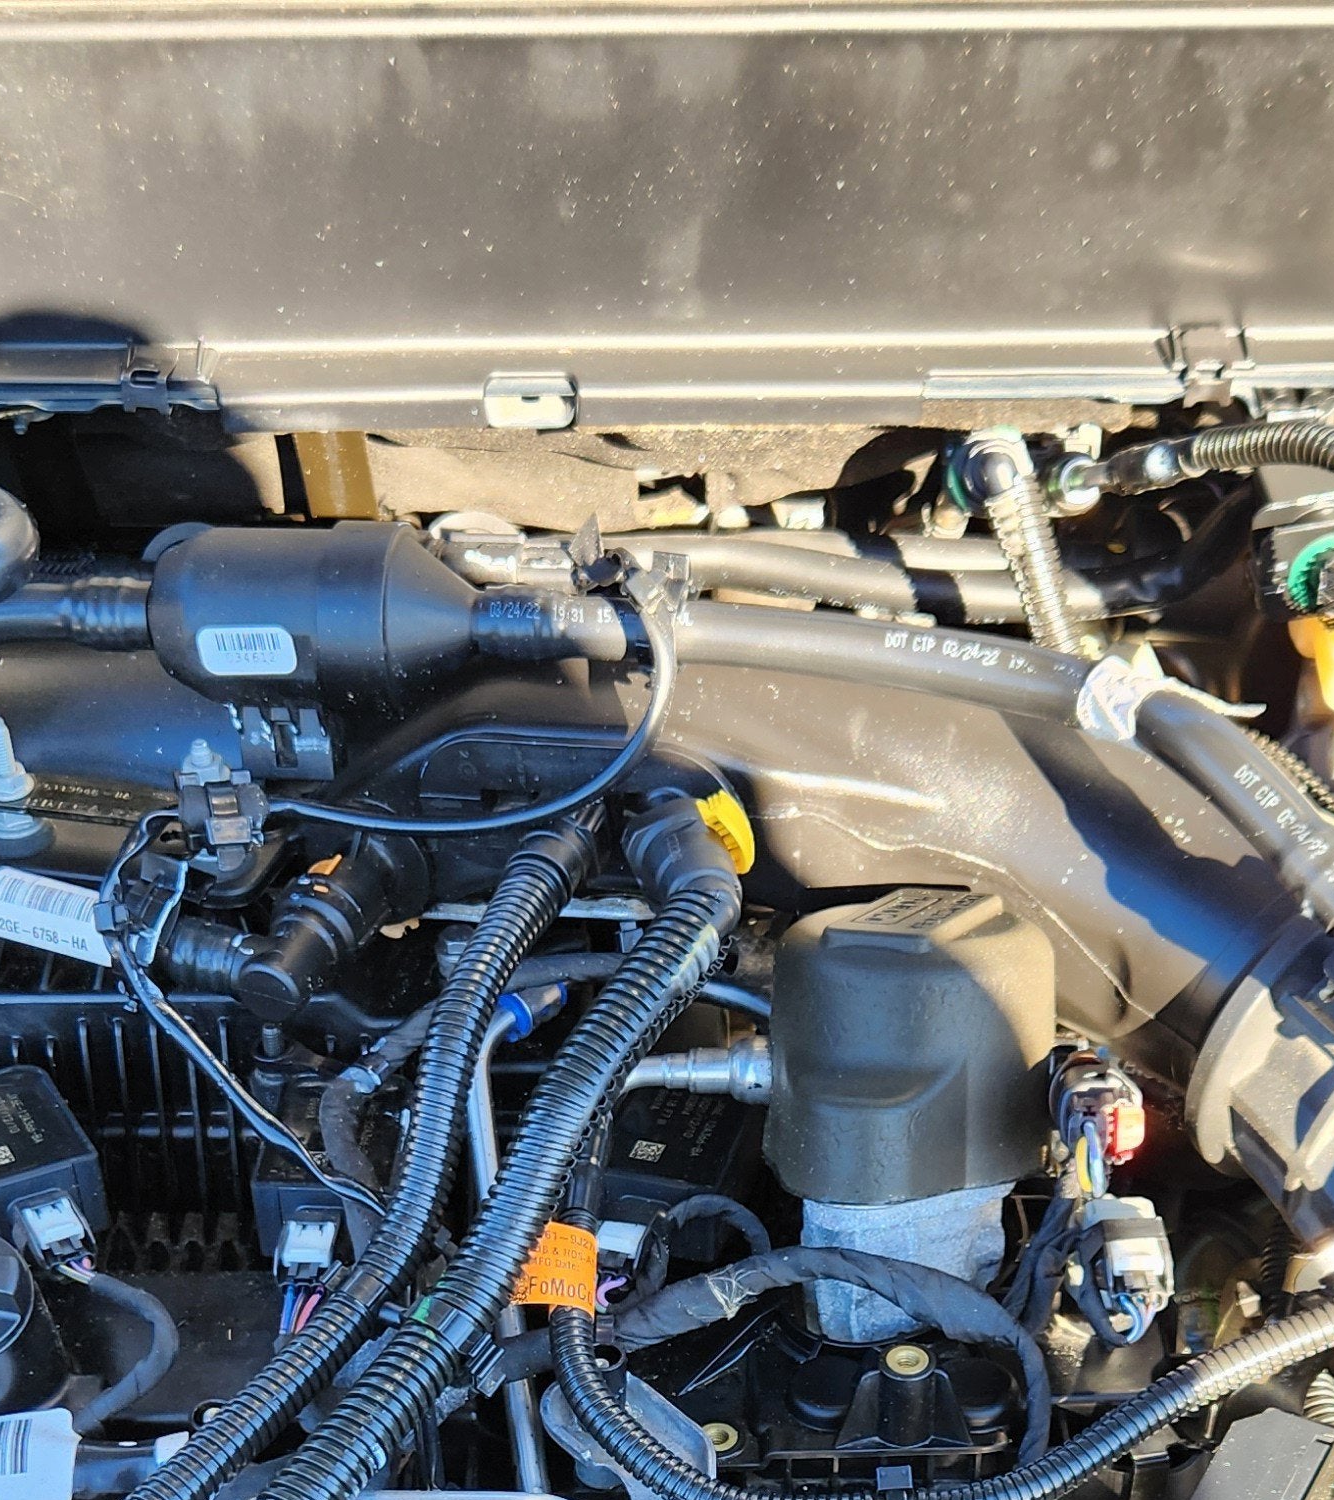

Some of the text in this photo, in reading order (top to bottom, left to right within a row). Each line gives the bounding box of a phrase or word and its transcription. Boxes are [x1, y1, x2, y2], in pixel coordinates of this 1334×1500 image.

[884, 631, 908, 648] DOT
[912, 635, 936, 653] CIP
[1233, 764, 1261, 789] DOT
[1254, 784, 1282, 810] CIP
